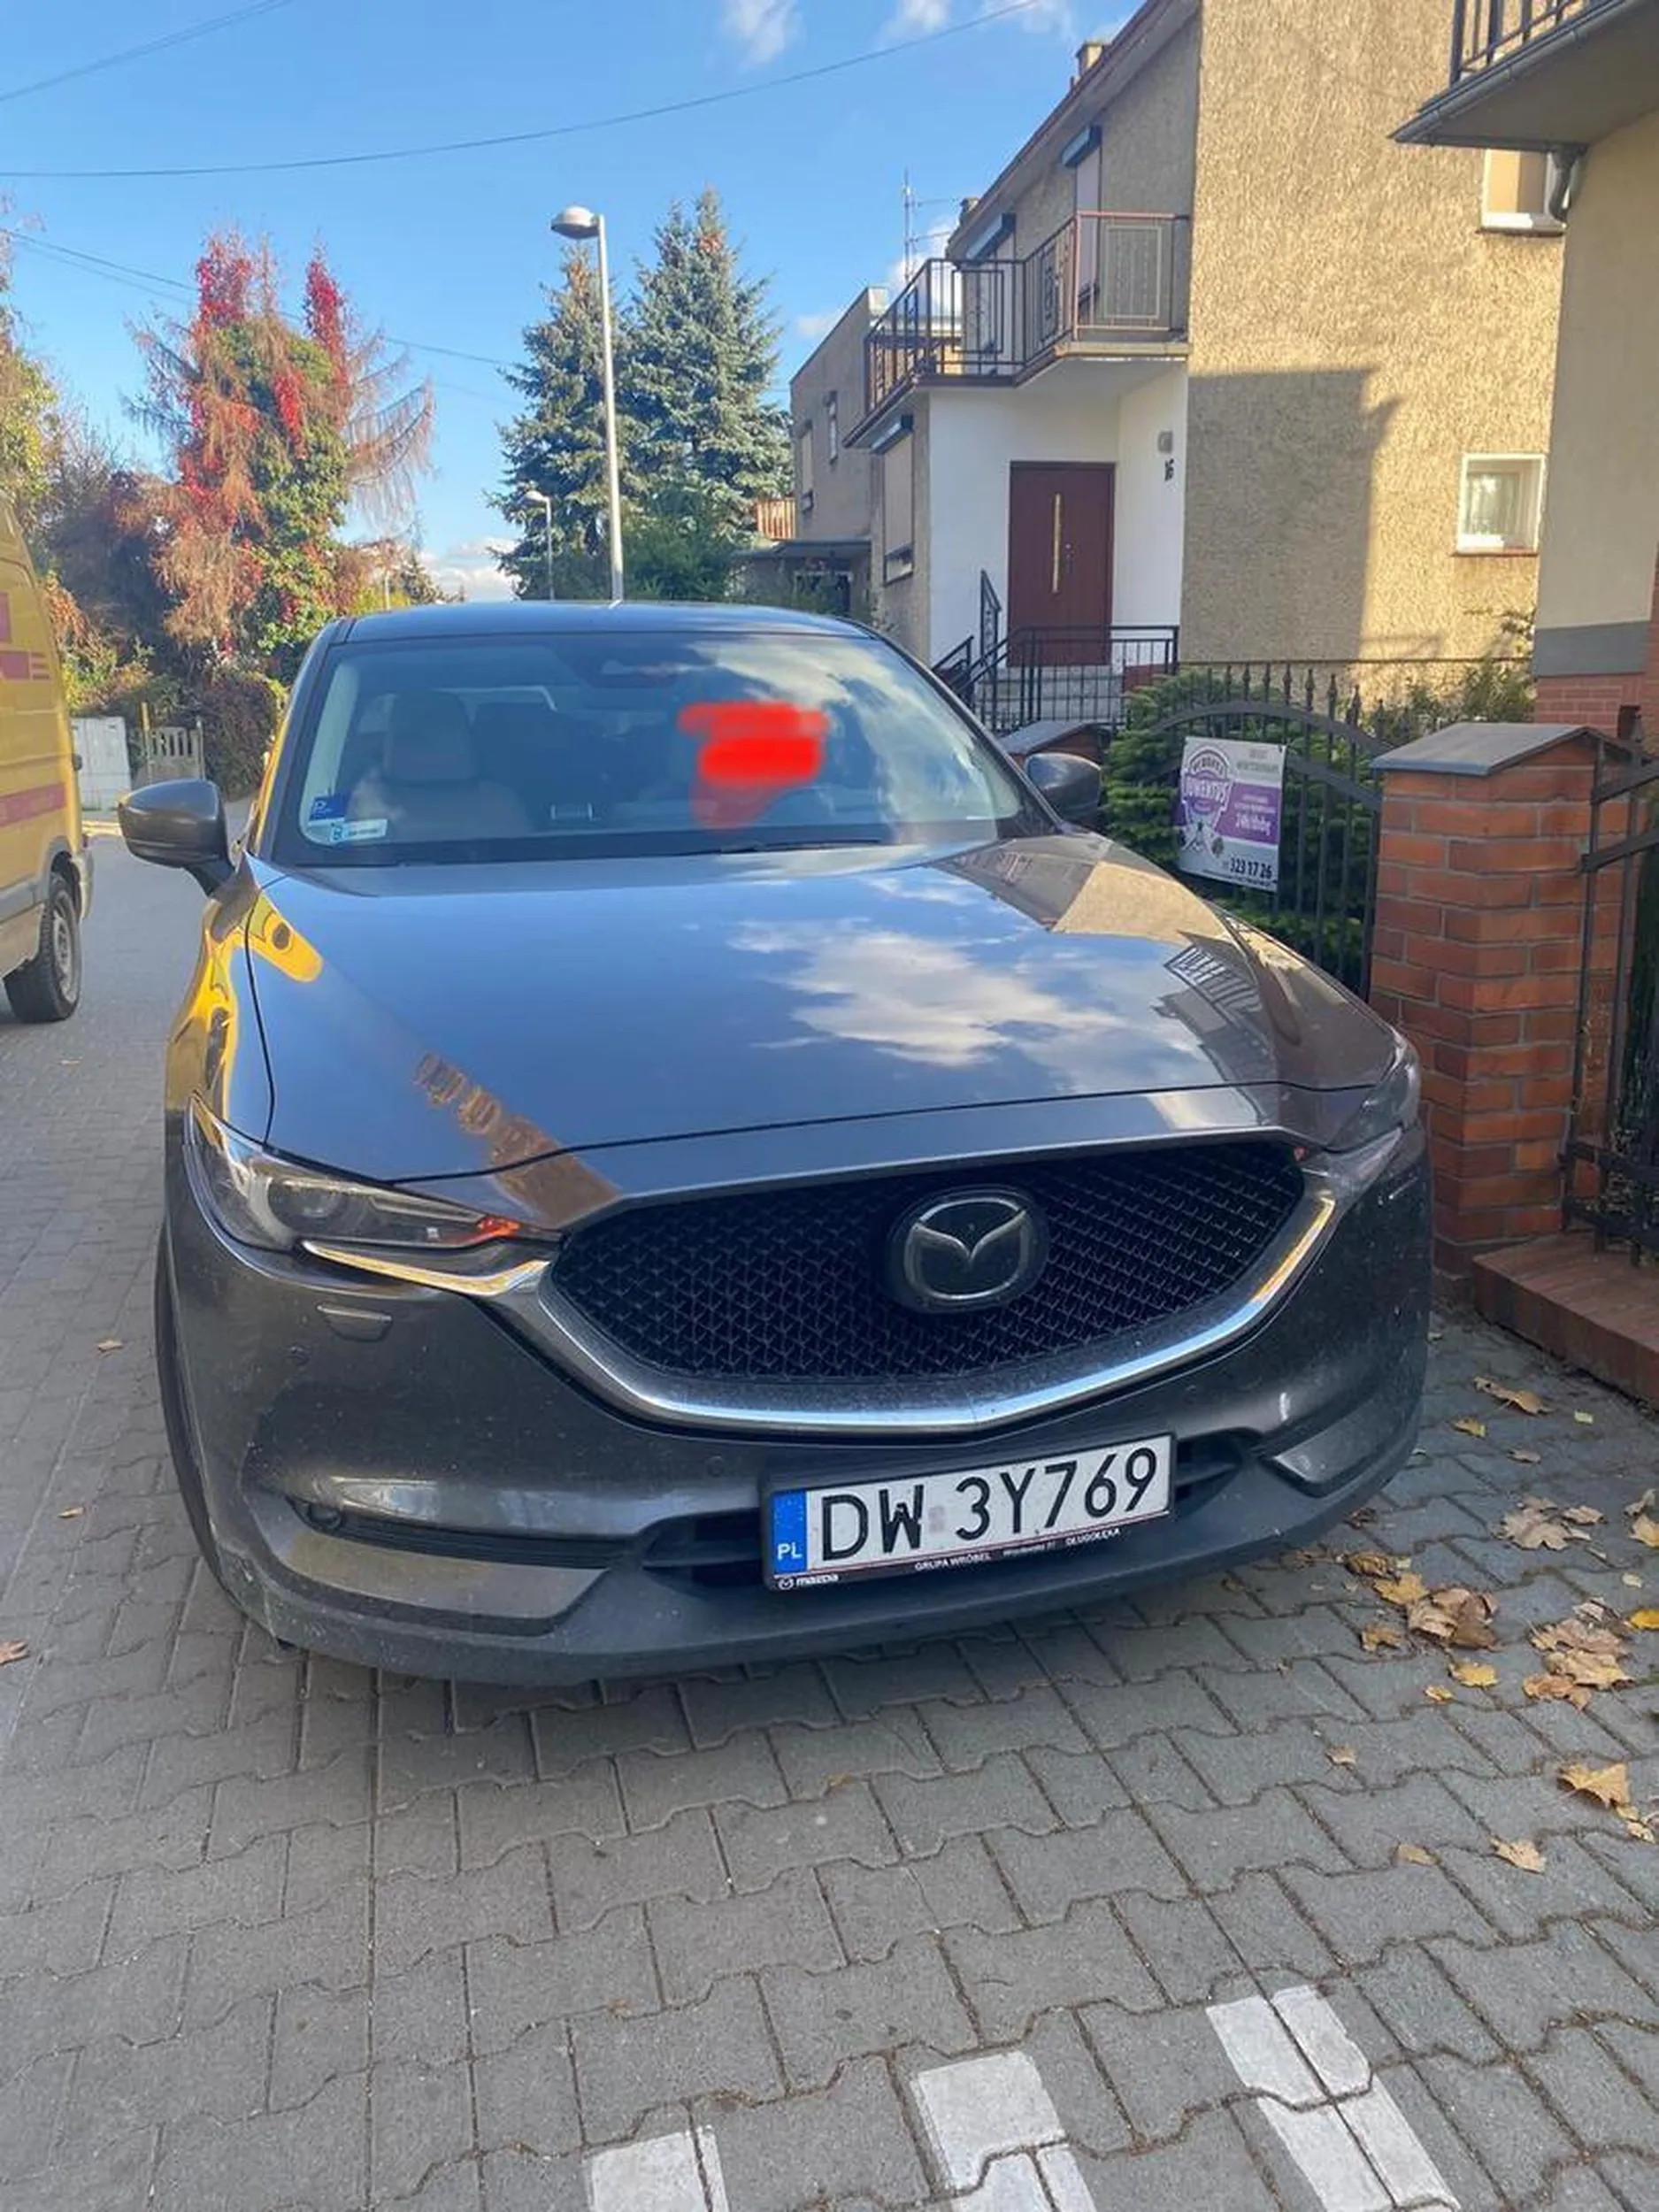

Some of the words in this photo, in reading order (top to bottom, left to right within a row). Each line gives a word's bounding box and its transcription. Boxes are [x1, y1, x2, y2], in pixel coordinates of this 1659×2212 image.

[821, 1484, 923, 1561] DW
[955, 1447, 1157, 1541] 3Y769
[778, 1542, 803, 1560] PL
[914, 1558, 949, 1571] GRUPA
